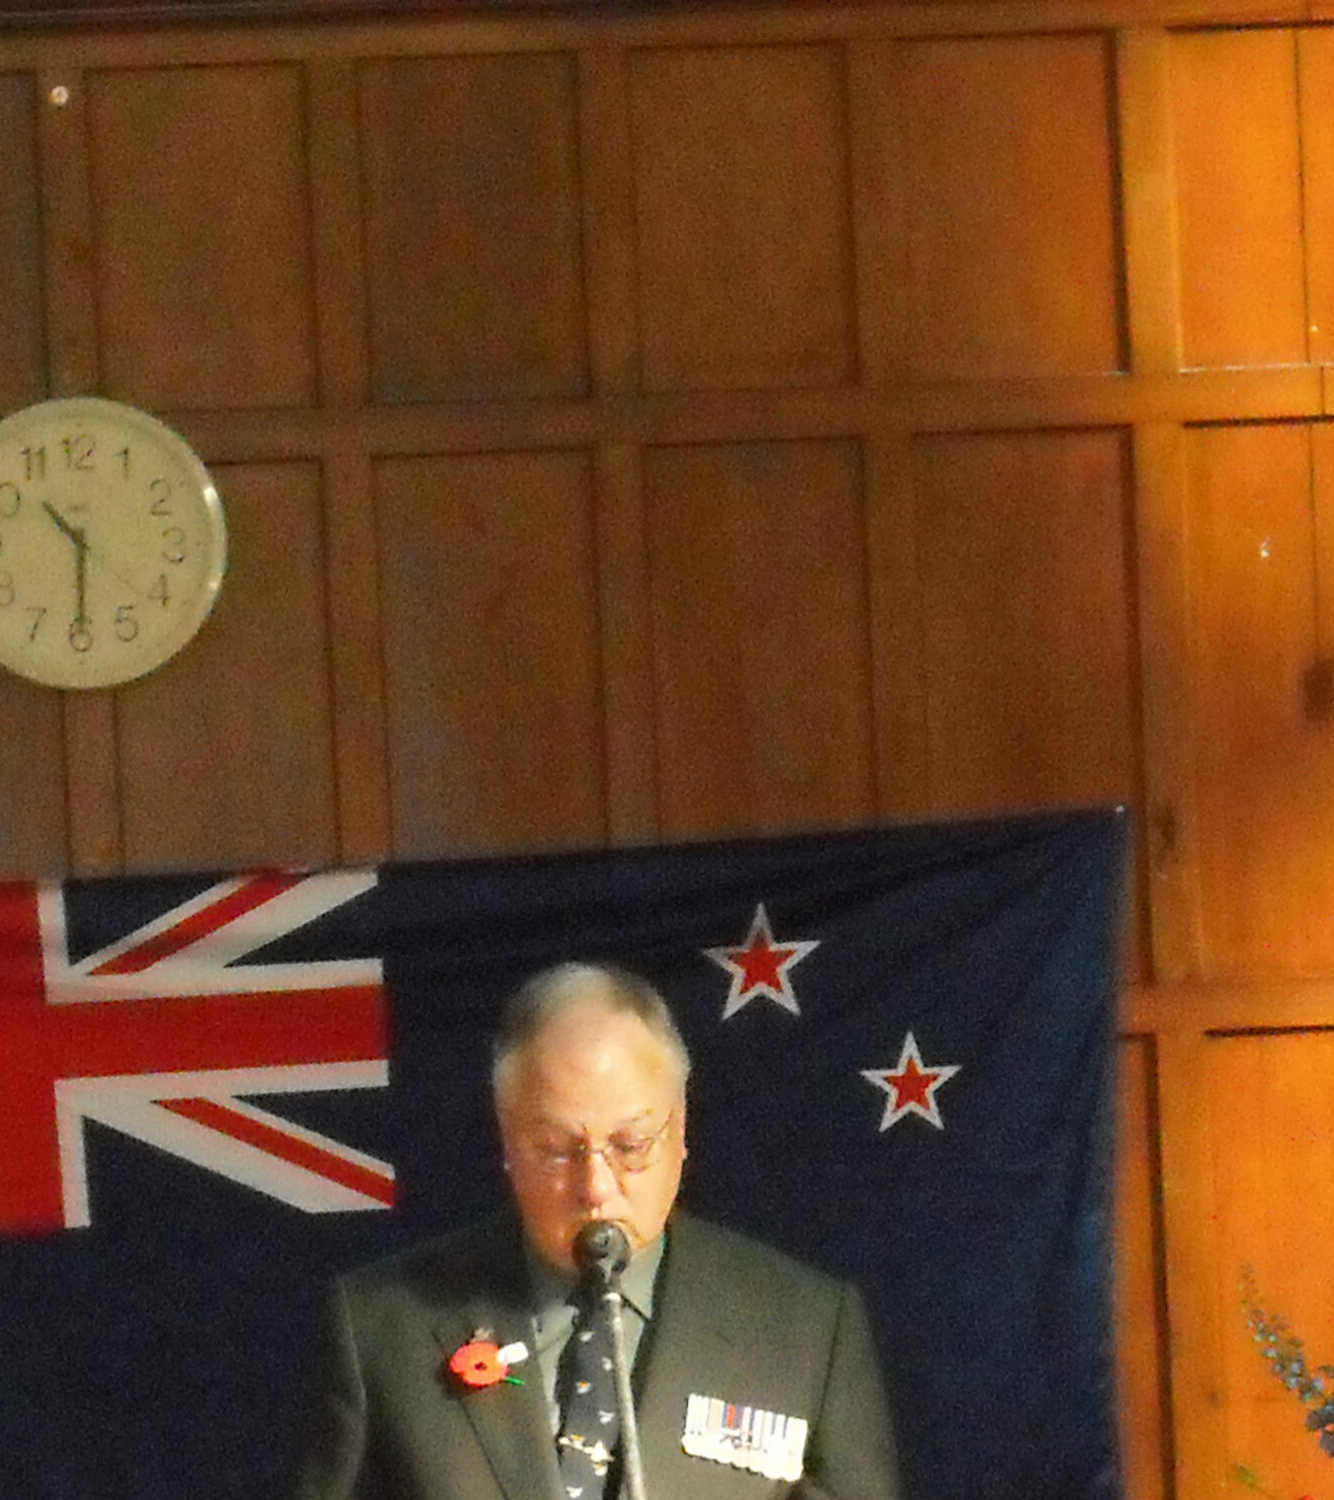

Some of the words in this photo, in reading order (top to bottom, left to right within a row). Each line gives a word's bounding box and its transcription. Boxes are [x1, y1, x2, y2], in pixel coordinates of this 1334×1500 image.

[21, 446, 46, 481] 11
[61, 434, 95, 471] 12
[116, 446, 131, 479] 1
[150, 478, 171, 516] 2
[162, 527, 186, 564] 3
[148, 573, 169, 607] 4
[25, 606, 47, 641] 7
[69, 617, 94, 652] 6
[116, 605, 139, 642] 5
